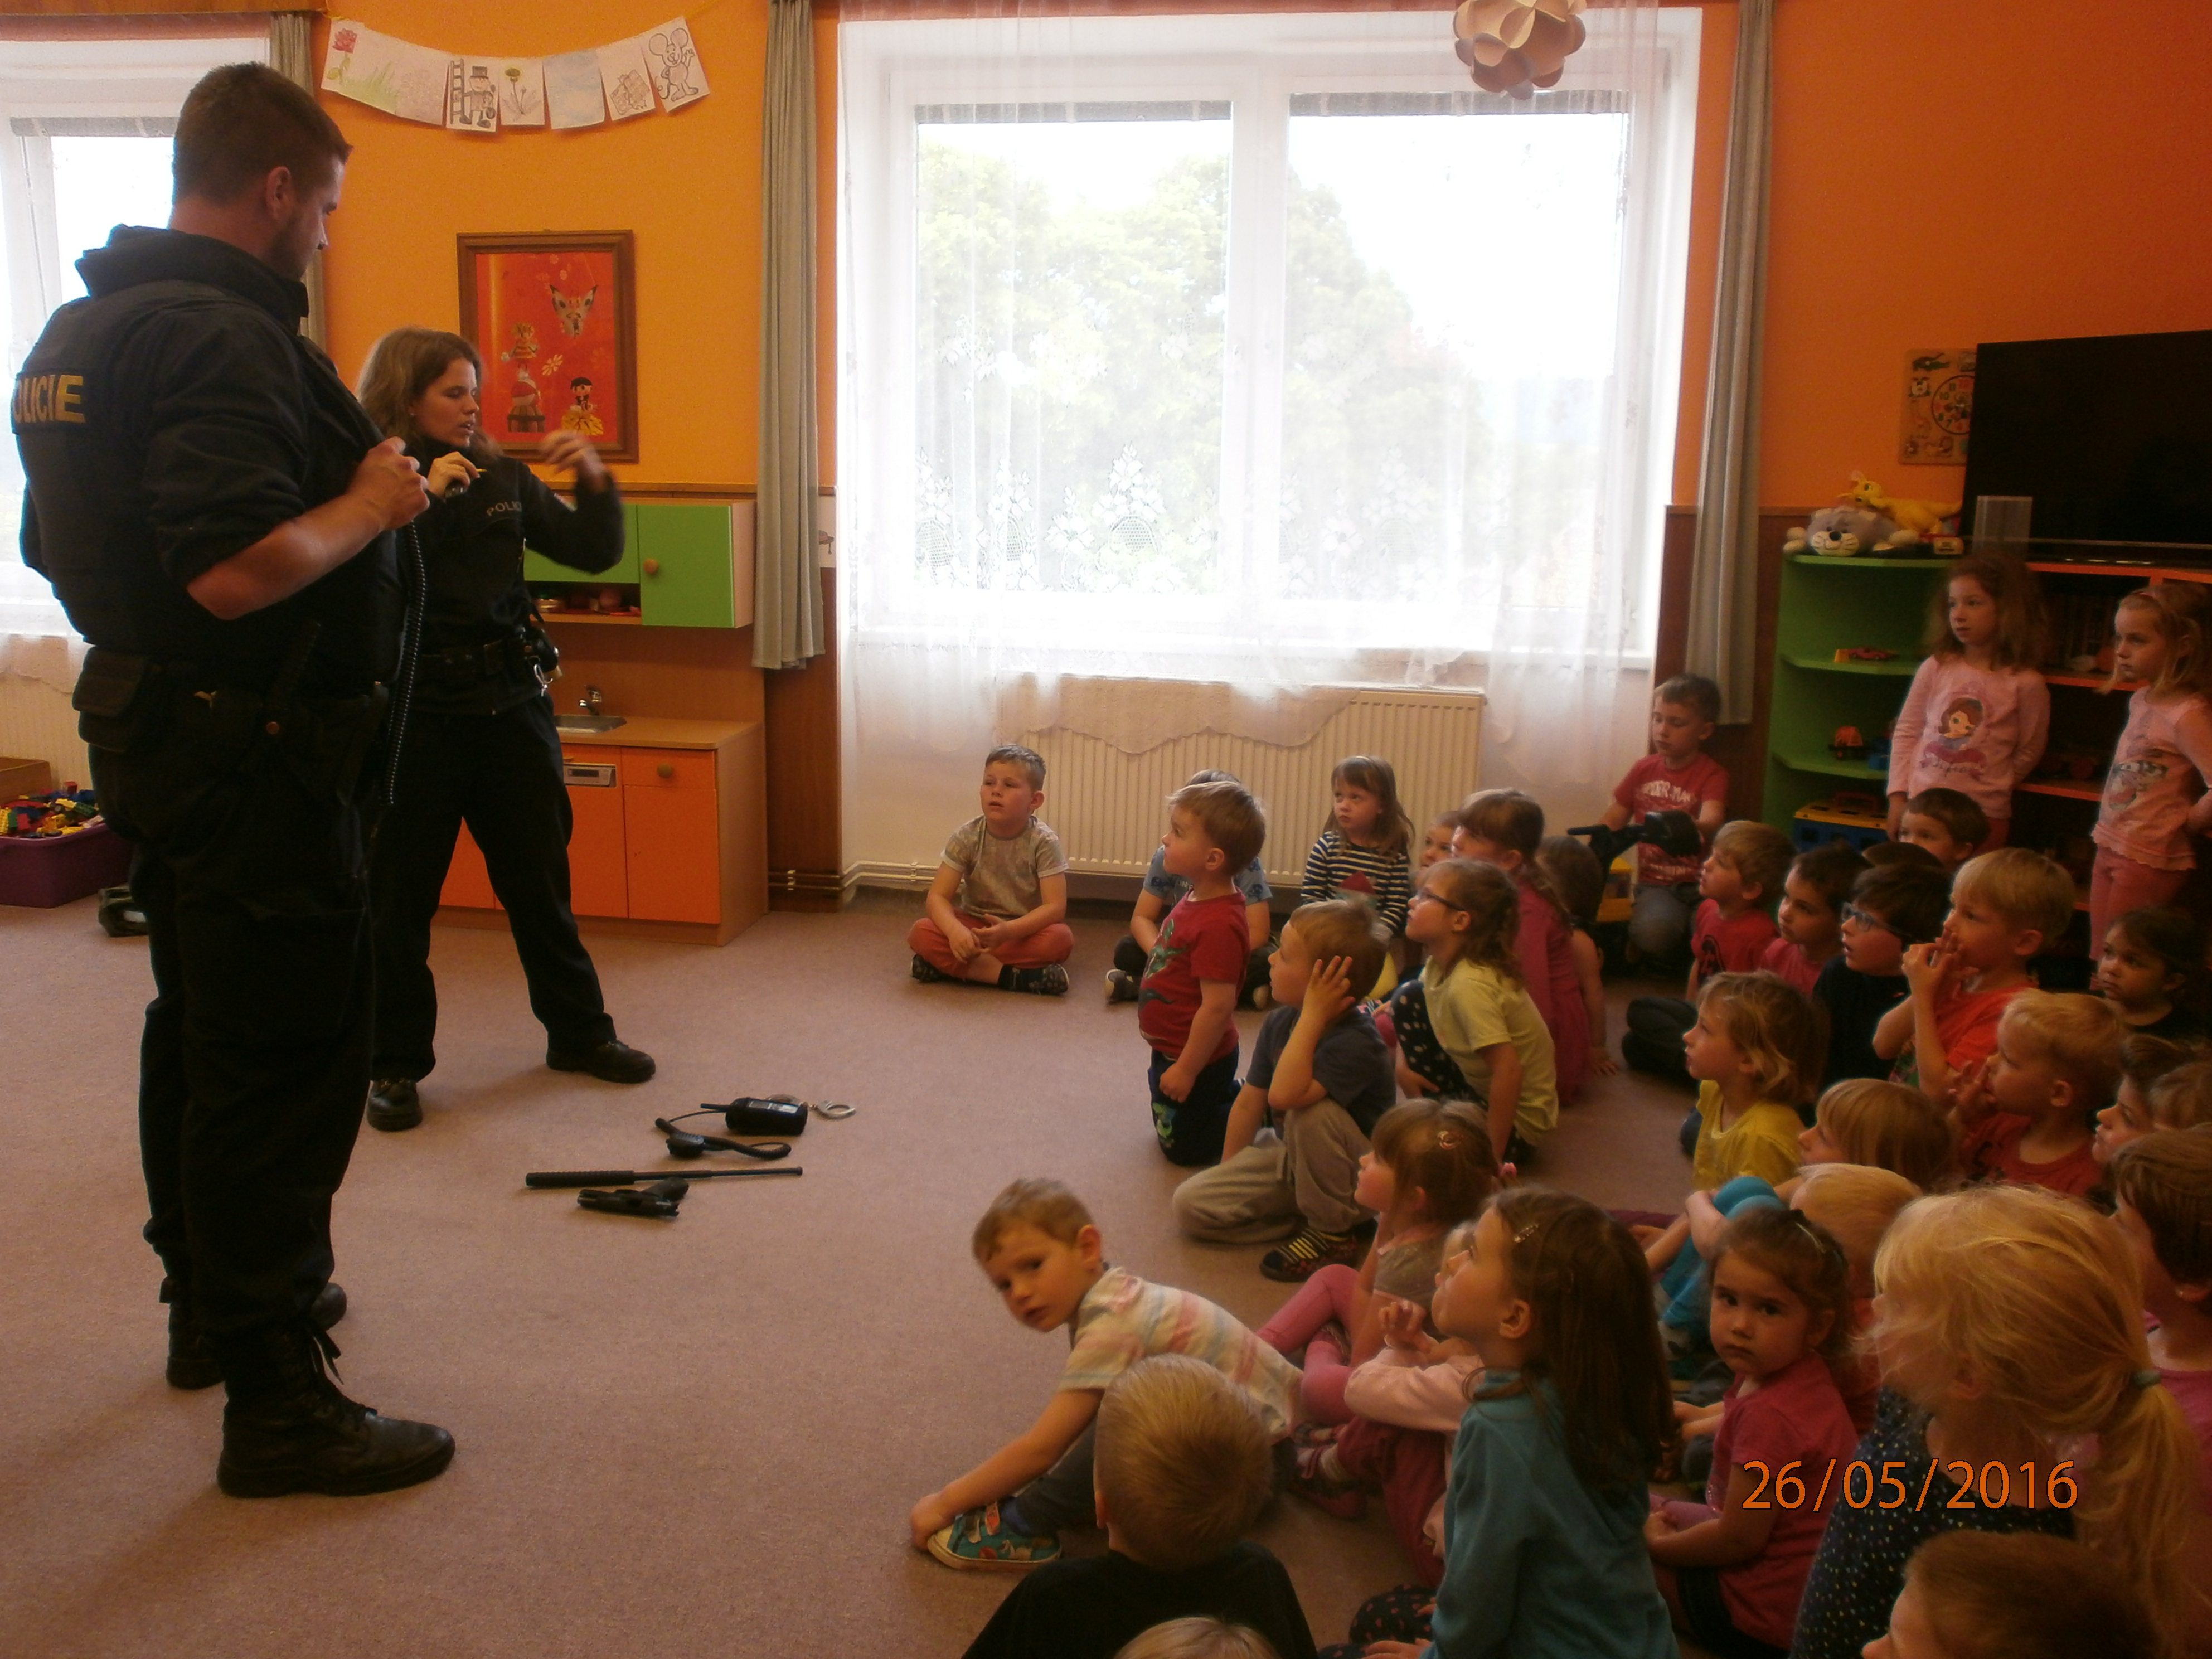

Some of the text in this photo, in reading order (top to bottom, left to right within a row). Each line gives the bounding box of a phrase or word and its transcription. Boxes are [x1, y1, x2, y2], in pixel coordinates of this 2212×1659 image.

[13, 374, 86, 423] OLICIE
[1939, 392, 1950, 400] 10
[486, 501, 522, 517] POLIC
